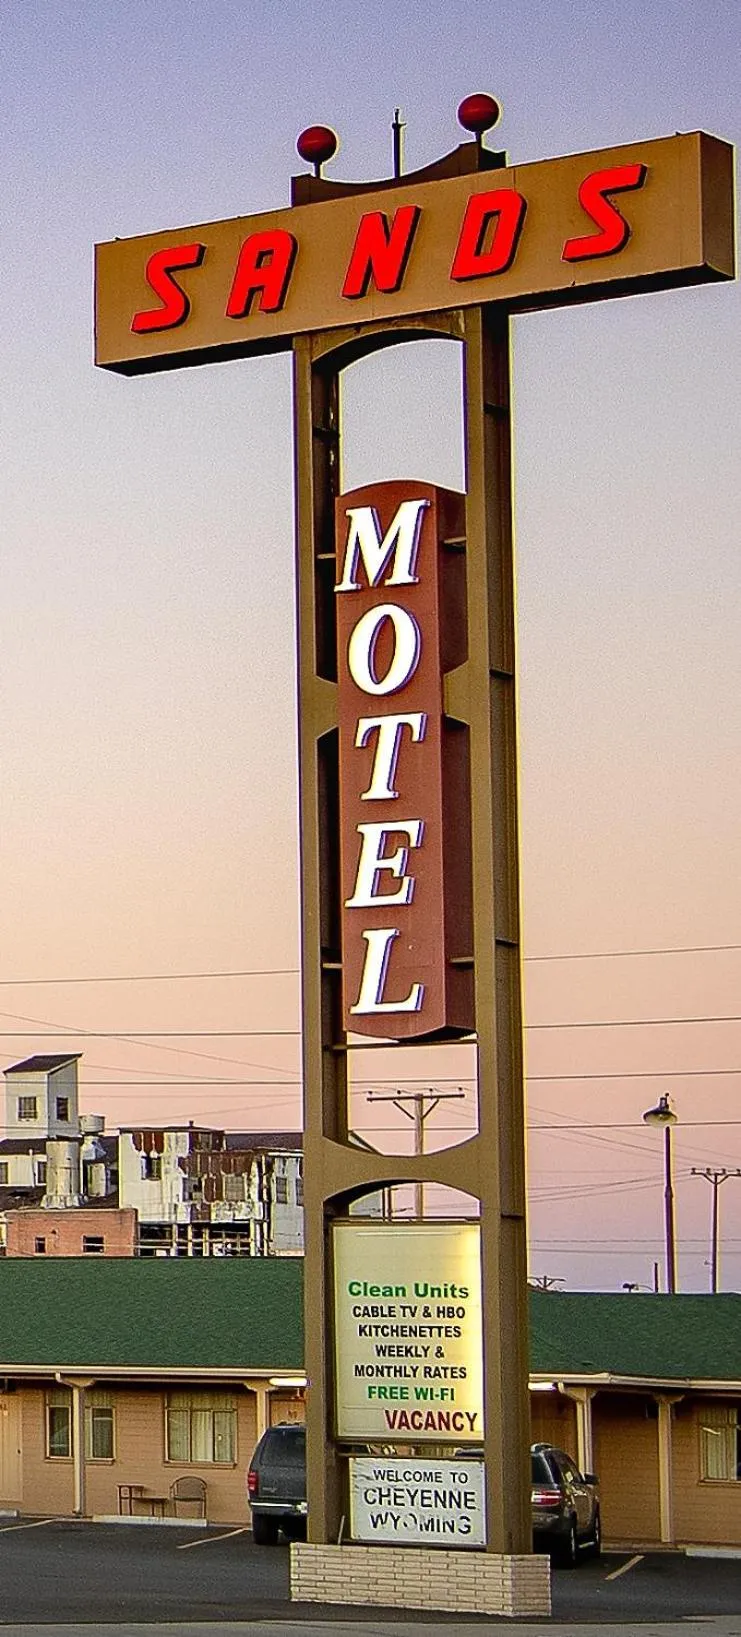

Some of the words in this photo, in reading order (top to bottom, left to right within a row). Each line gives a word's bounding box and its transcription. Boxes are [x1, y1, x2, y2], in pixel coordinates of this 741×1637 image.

[131, 164, 648, 334] SANDS
[334, 499, 432, 1016] MOTEL
[348, 1281, 407, 1298] Clean
[414, 1283, 469, 1299] Units
[352, 1305, 396, 1318] CABLE
[400, 1305, 418, 1318] TV
[422, 1306, 432, 1318] &
[436, 1306, 466, 1319] HBO
[358, 1325, 462, 1338] KITCHENETTES
[375, 1345, 430, 1358] WEEKLY
[435, 1346, 445, 1358] &
[354, 1365, 419, 1378] MONTHLY
[423, 1366, 467, 1379] RATES
[367, 1386, 409, 1400] FREE
[414, 1387, 455, 1401] WI-FI
[384, 1410, 478, 1432] VACANCY
[373, 1469, 443, 1483] WELCOME
[450, 1472, 469, 1484] TO
[363, 1487, 476, 1510] CHEYENNE
